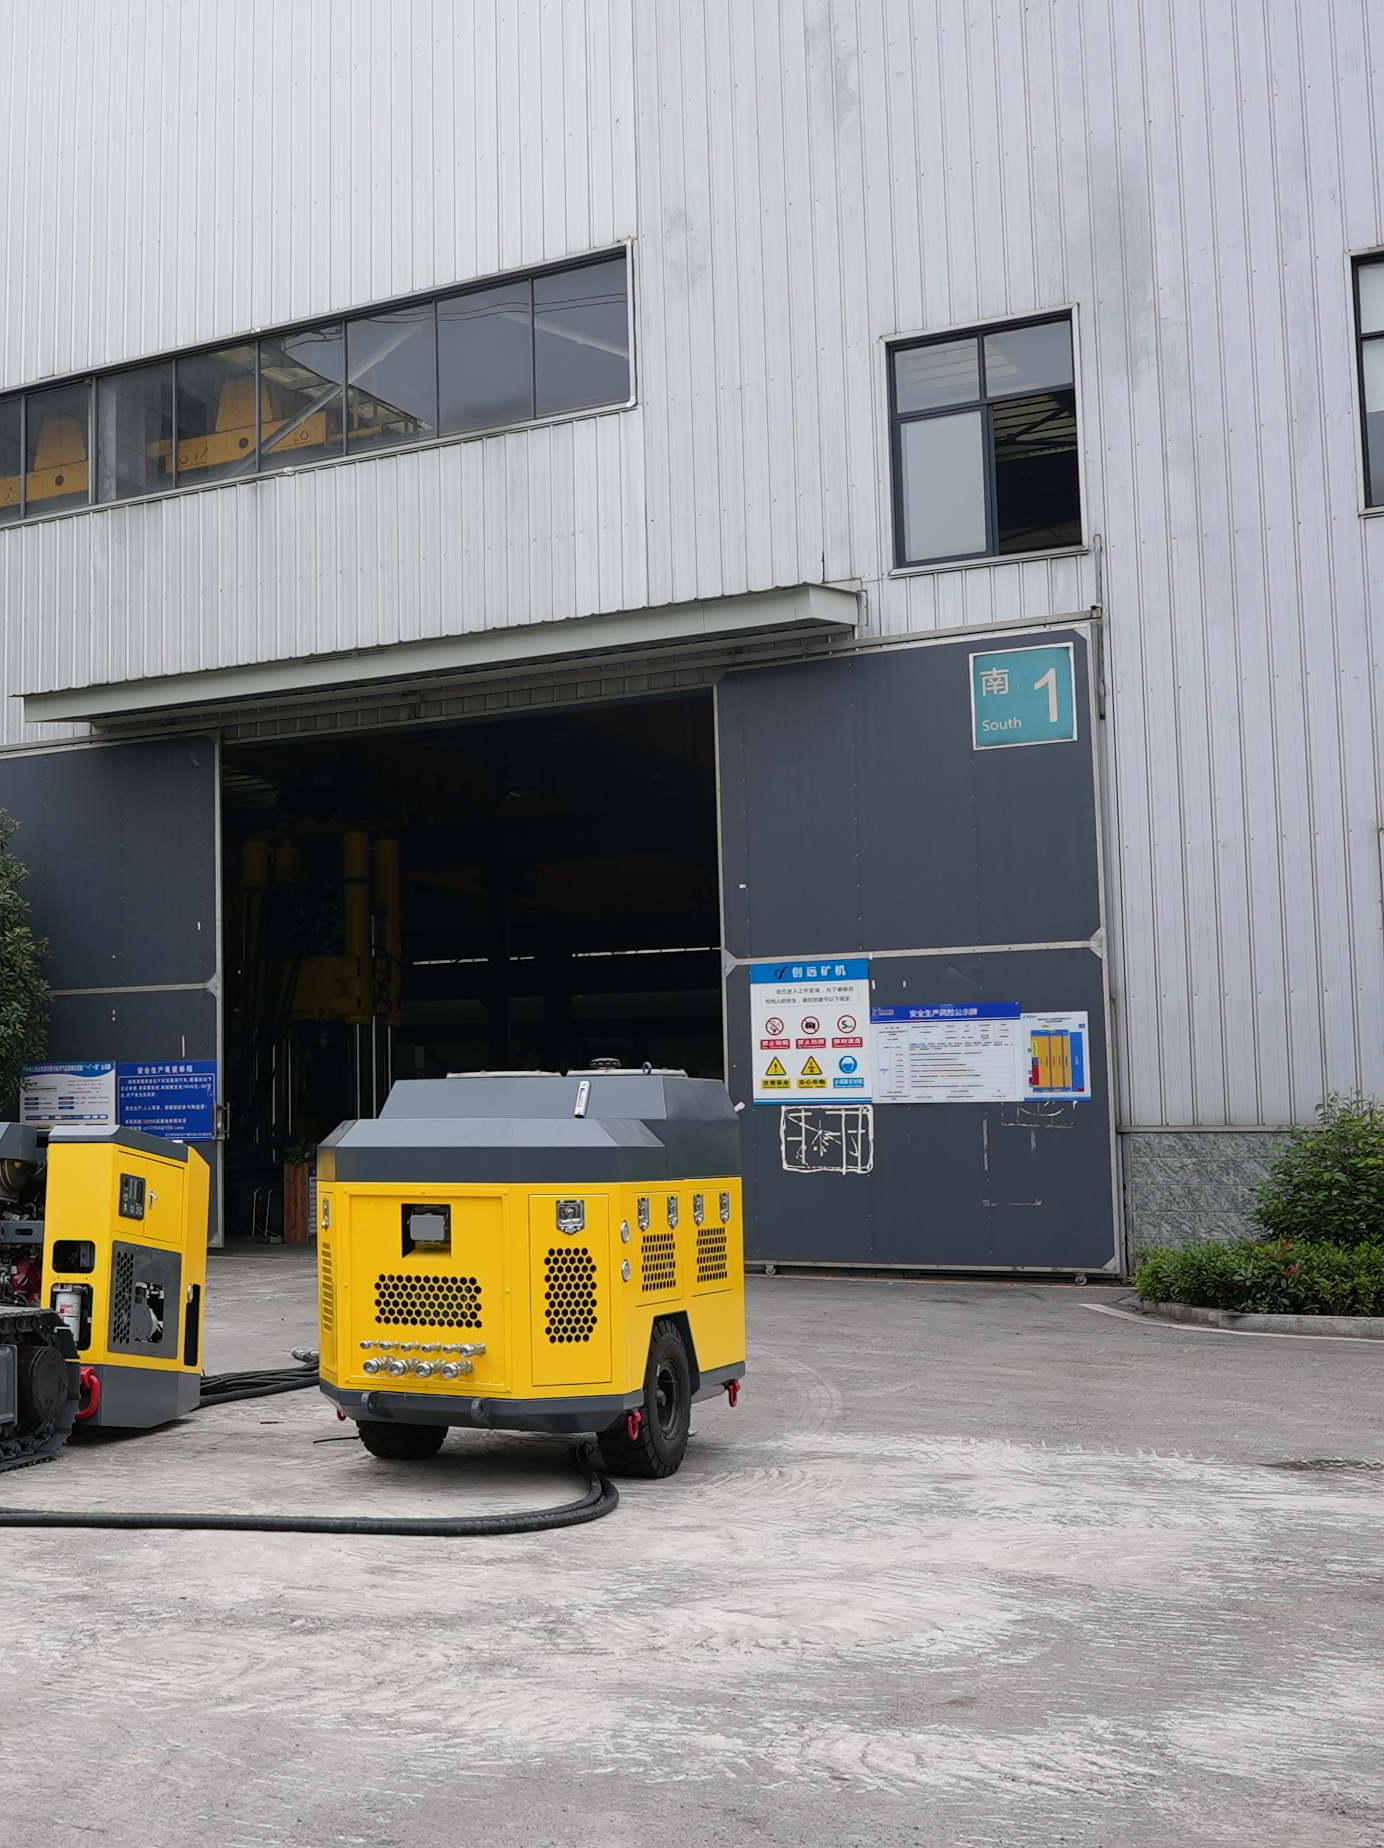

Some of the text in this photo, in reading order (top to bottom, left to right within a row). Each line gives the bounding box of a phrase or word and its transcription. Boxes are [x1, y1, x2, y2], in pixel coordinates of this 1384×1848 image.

[979, 667, 1009, 696] 南
[1033, 667, 1058, 722] 1
[981, 717, 1022, 732] South
[792, 964, 847, 978] 创远矿机
